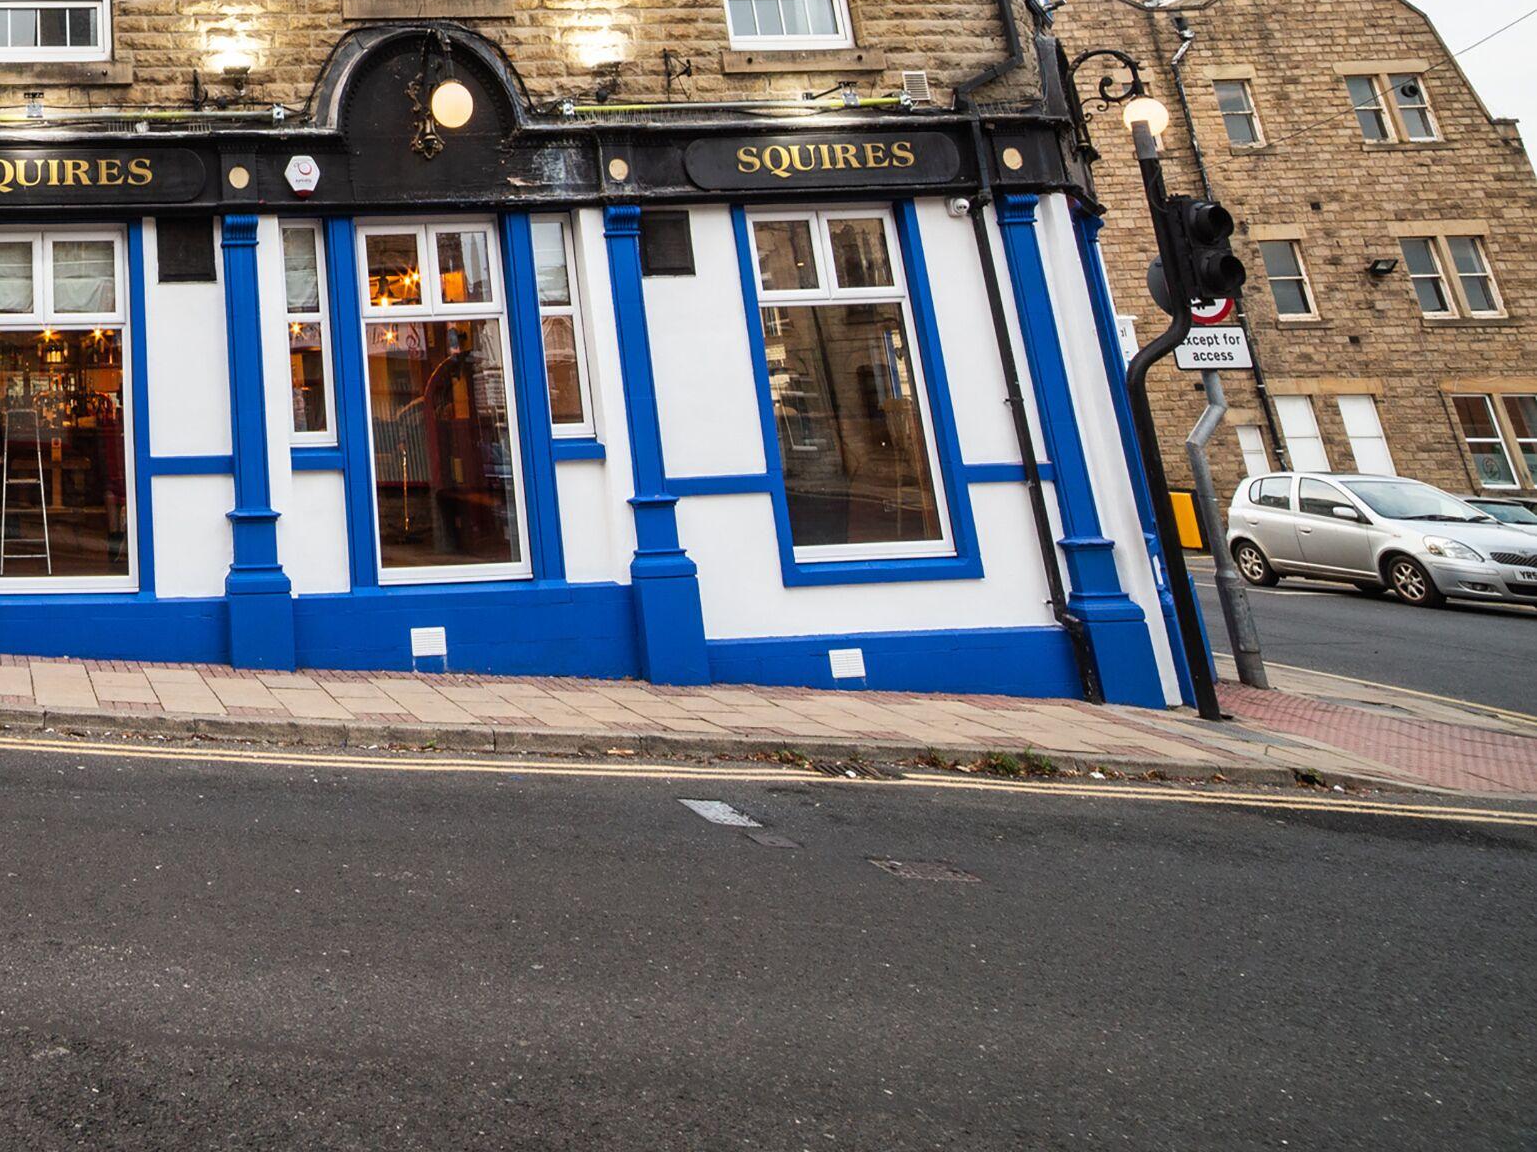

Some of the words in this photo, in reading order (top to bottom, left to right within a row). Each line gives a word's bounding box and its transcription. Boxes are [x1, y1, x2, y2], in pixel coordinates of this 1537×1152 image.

[736, 140, 916, 179] SQUIRES
[1222, 332, 1240, 346] for
[1192, 351, 1235, 362] access
